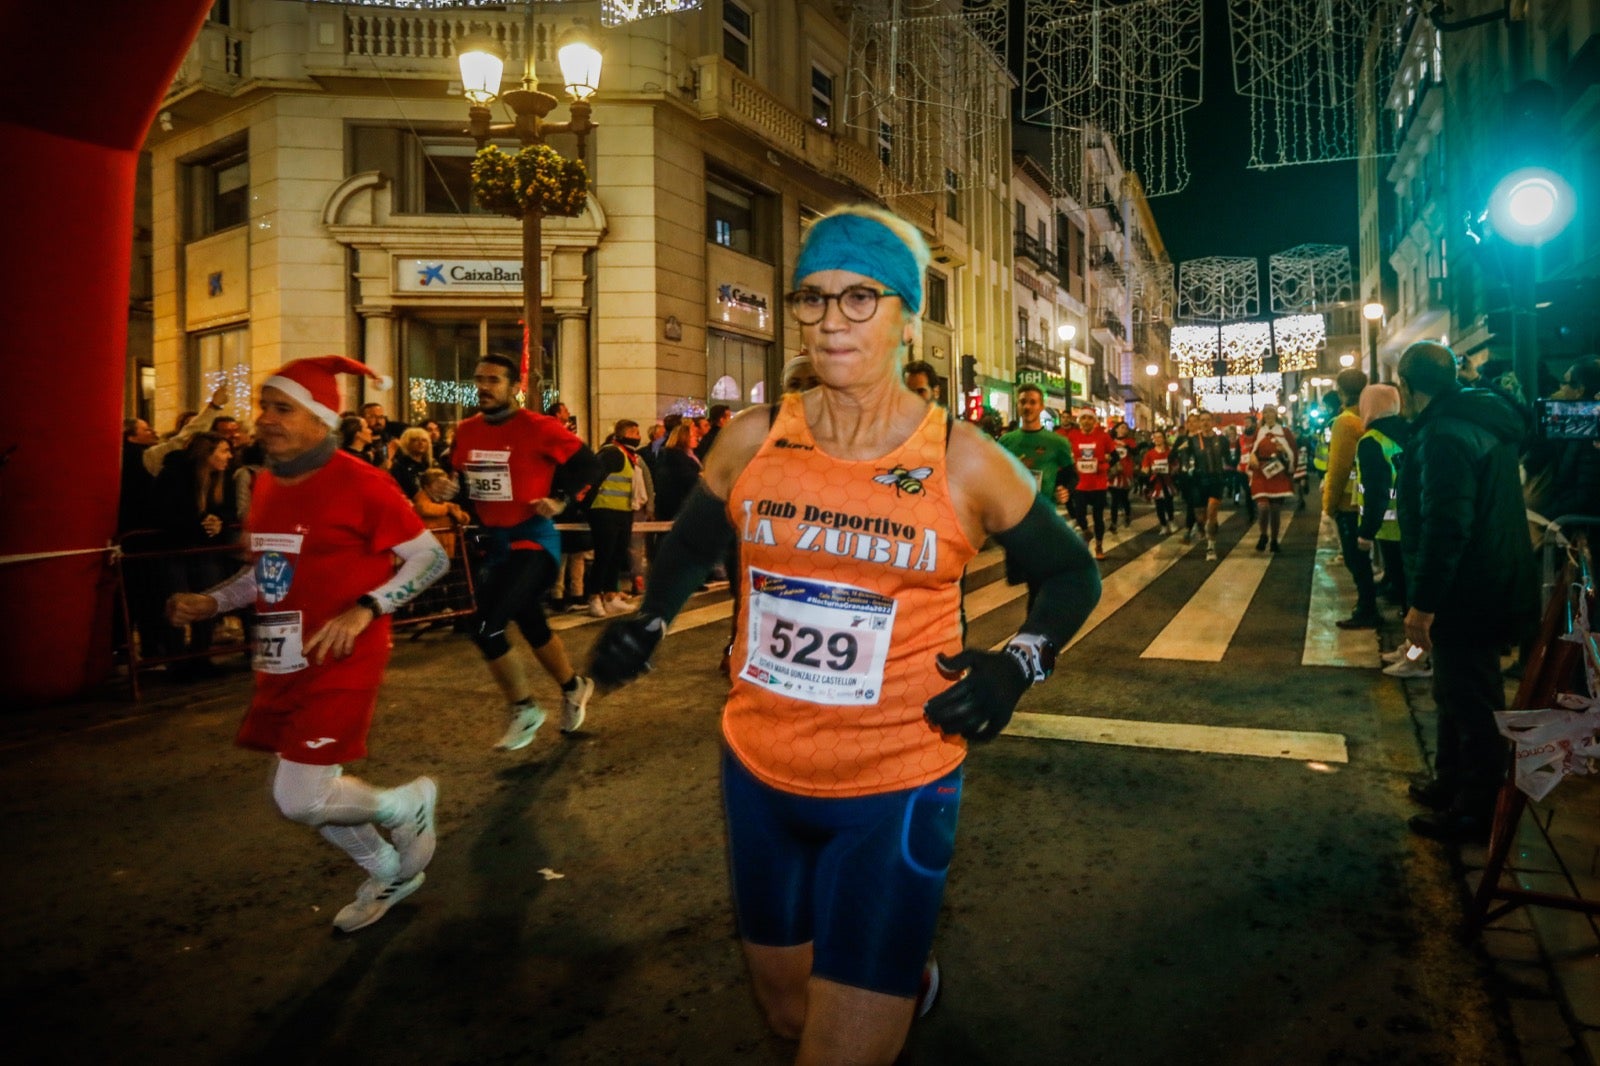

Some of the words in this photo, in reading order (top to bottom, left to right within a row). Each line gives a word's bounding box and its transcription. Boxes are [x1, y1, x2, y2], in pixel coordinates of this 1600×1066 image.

[1018, 372, 1042, 384] 16H
[742, 499, 777, 546] LA
[793, 523, 938, 573] ZUBIA
[757, 499, 797, 519] Club
[803, 504, 916, 540] Deportivo
[771, 618, 859, 672] 529
[774, 662, 791, 676] MARIA
[790, 668, 822, 684] GONZALEZ
[821, 675, 858, 687] CASTELLON
